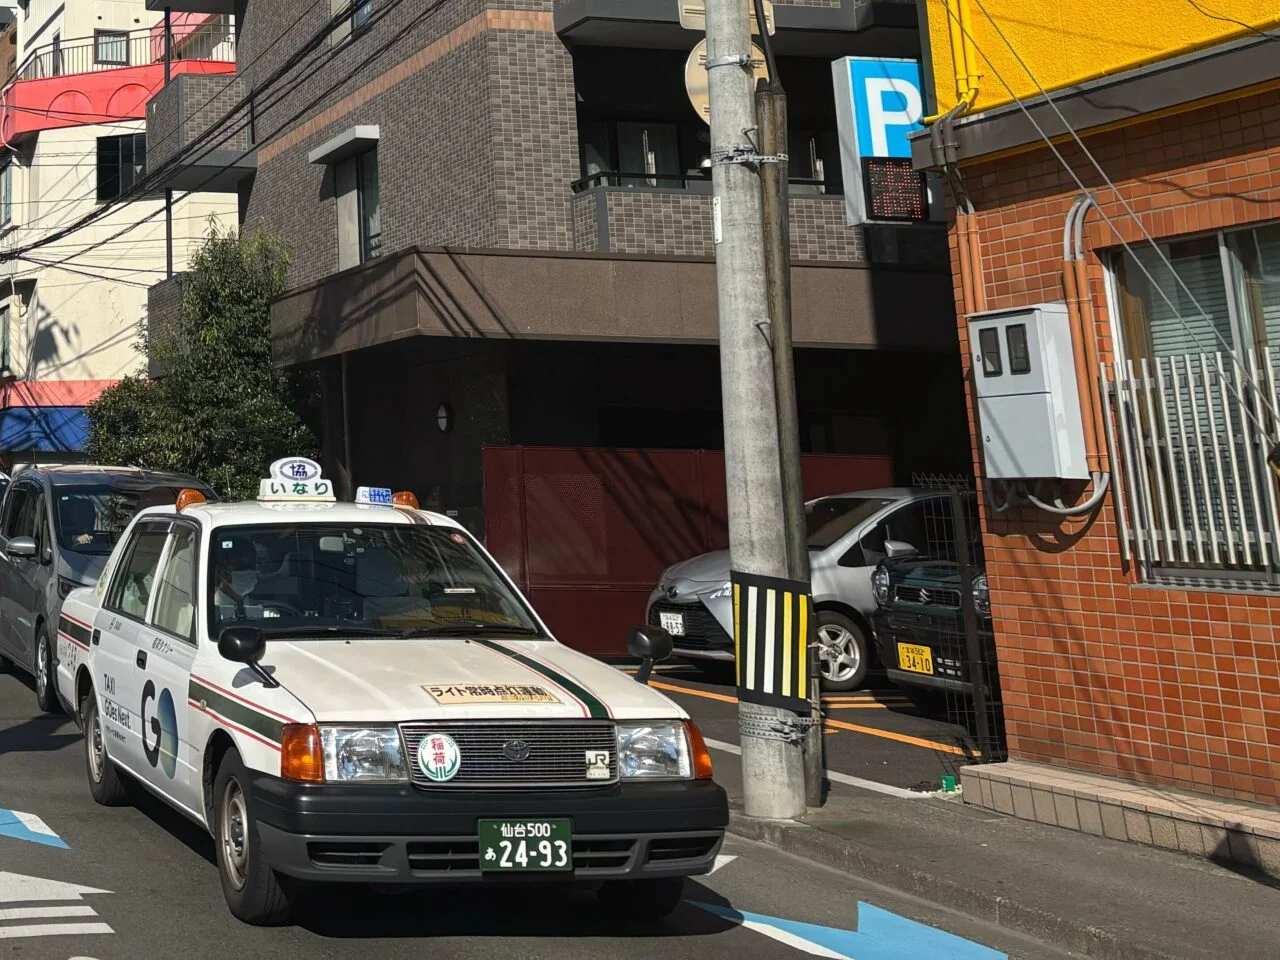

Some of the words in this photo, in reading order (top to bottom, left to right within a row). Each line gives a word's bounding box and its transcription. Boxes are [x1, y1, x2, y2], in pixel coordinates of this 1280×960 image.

[864, 77, 923, 157] P
[289, 463, 308, 477] 協
[271, 482, 328, 495] いなり
[906, 655, 931, 672] 34-10
[103, 673, 116, 696] TAXI
[140, 679, 179, 780] GO
[431, 738, 445, 765] 稲荷
[588, 753, 609, 766] JR
[500, 822, 551, 838] 仙台500
[484, 847, 497, 861] あ
[499, 840, 568, 868] 24-93
